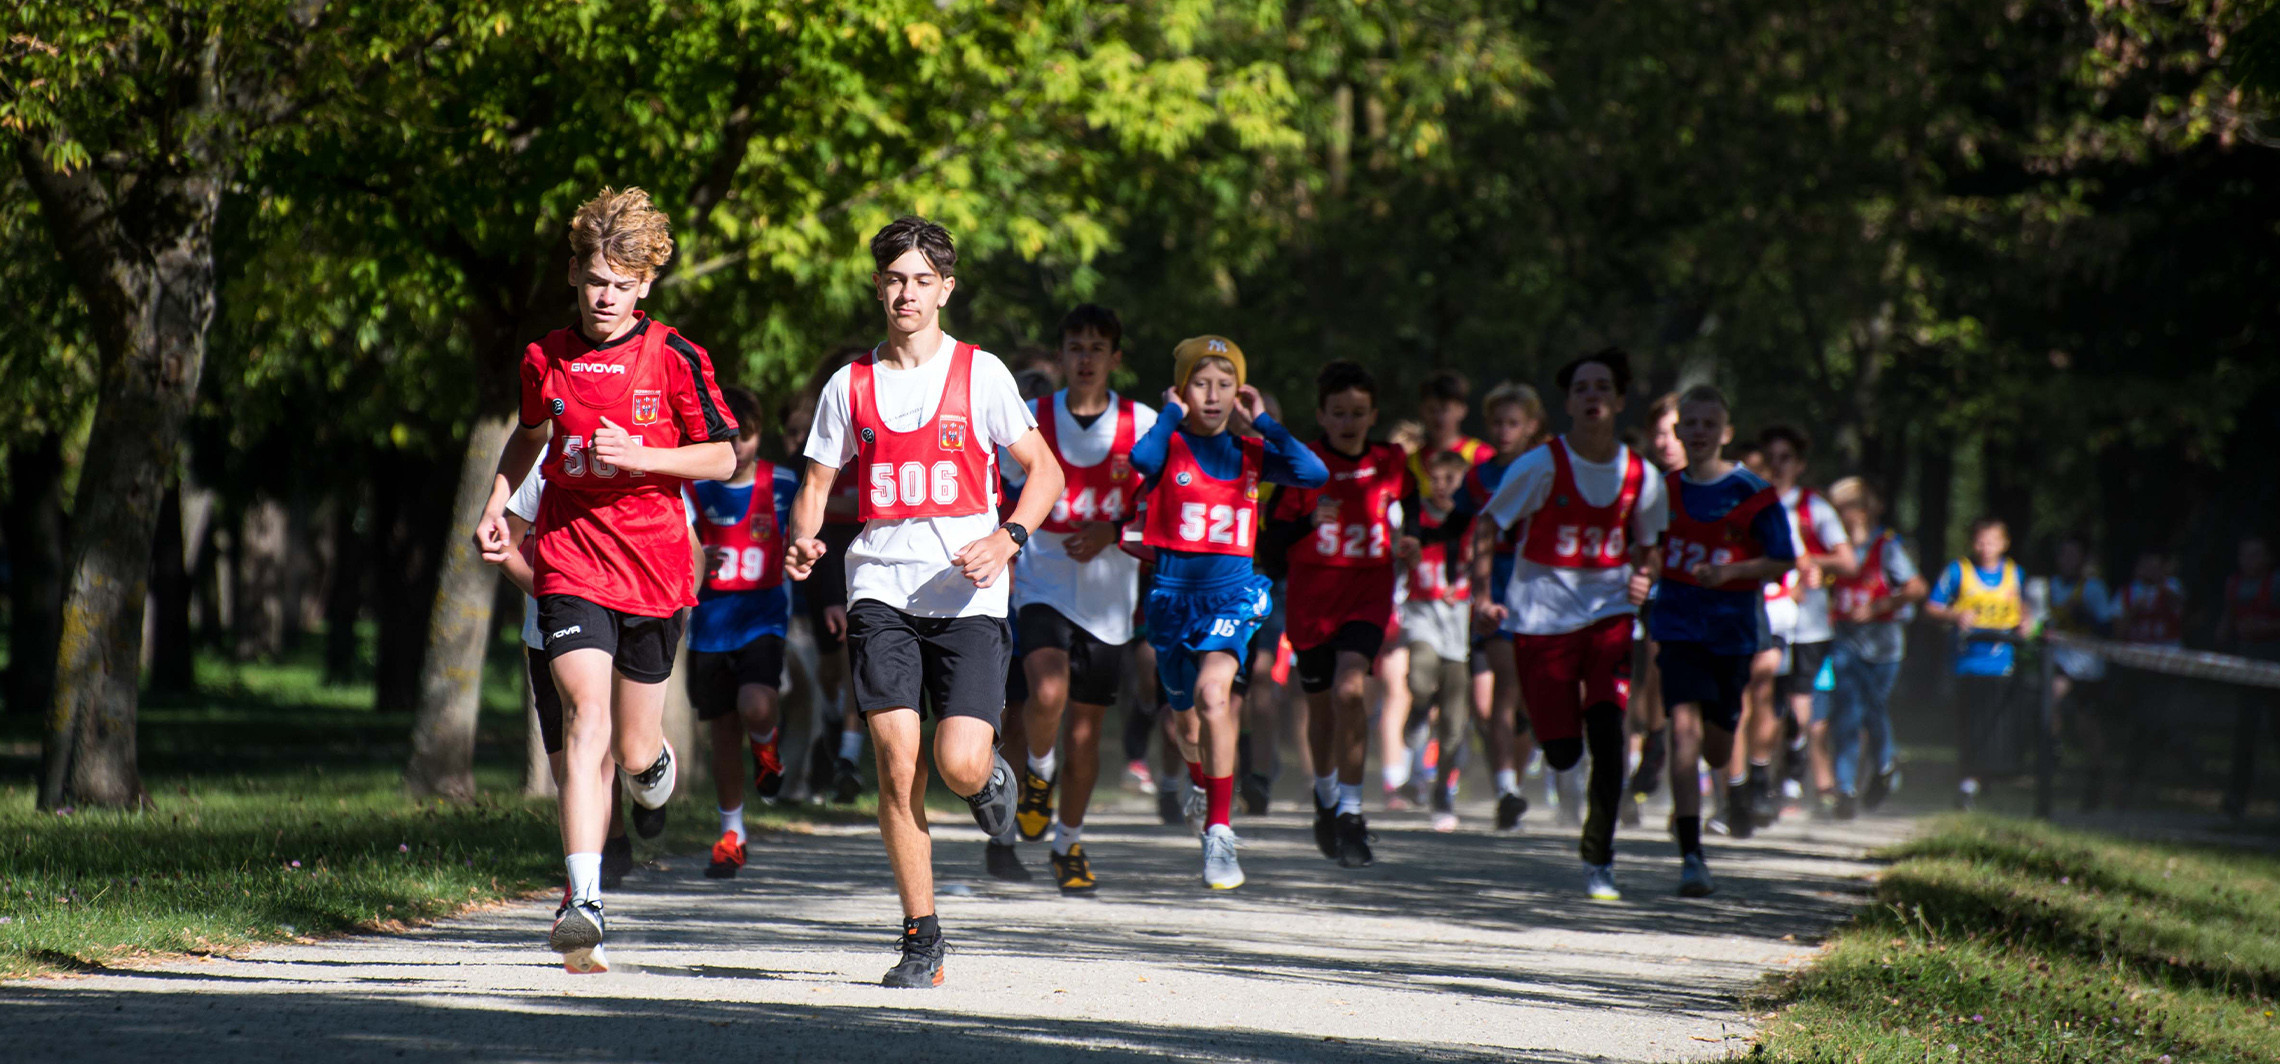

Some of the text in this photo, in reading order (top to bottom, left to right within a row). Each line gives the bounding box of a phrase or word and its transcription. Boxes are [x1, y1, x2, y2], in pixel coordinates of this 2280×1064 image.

[571, 363, 625, 375] GIVOVA
[870, 461, 958, 507] 506
[1179, 502, 1252, 547] 521
[1316, 523, 1385, 558] 522
[704, 546, 764, 581] 39
